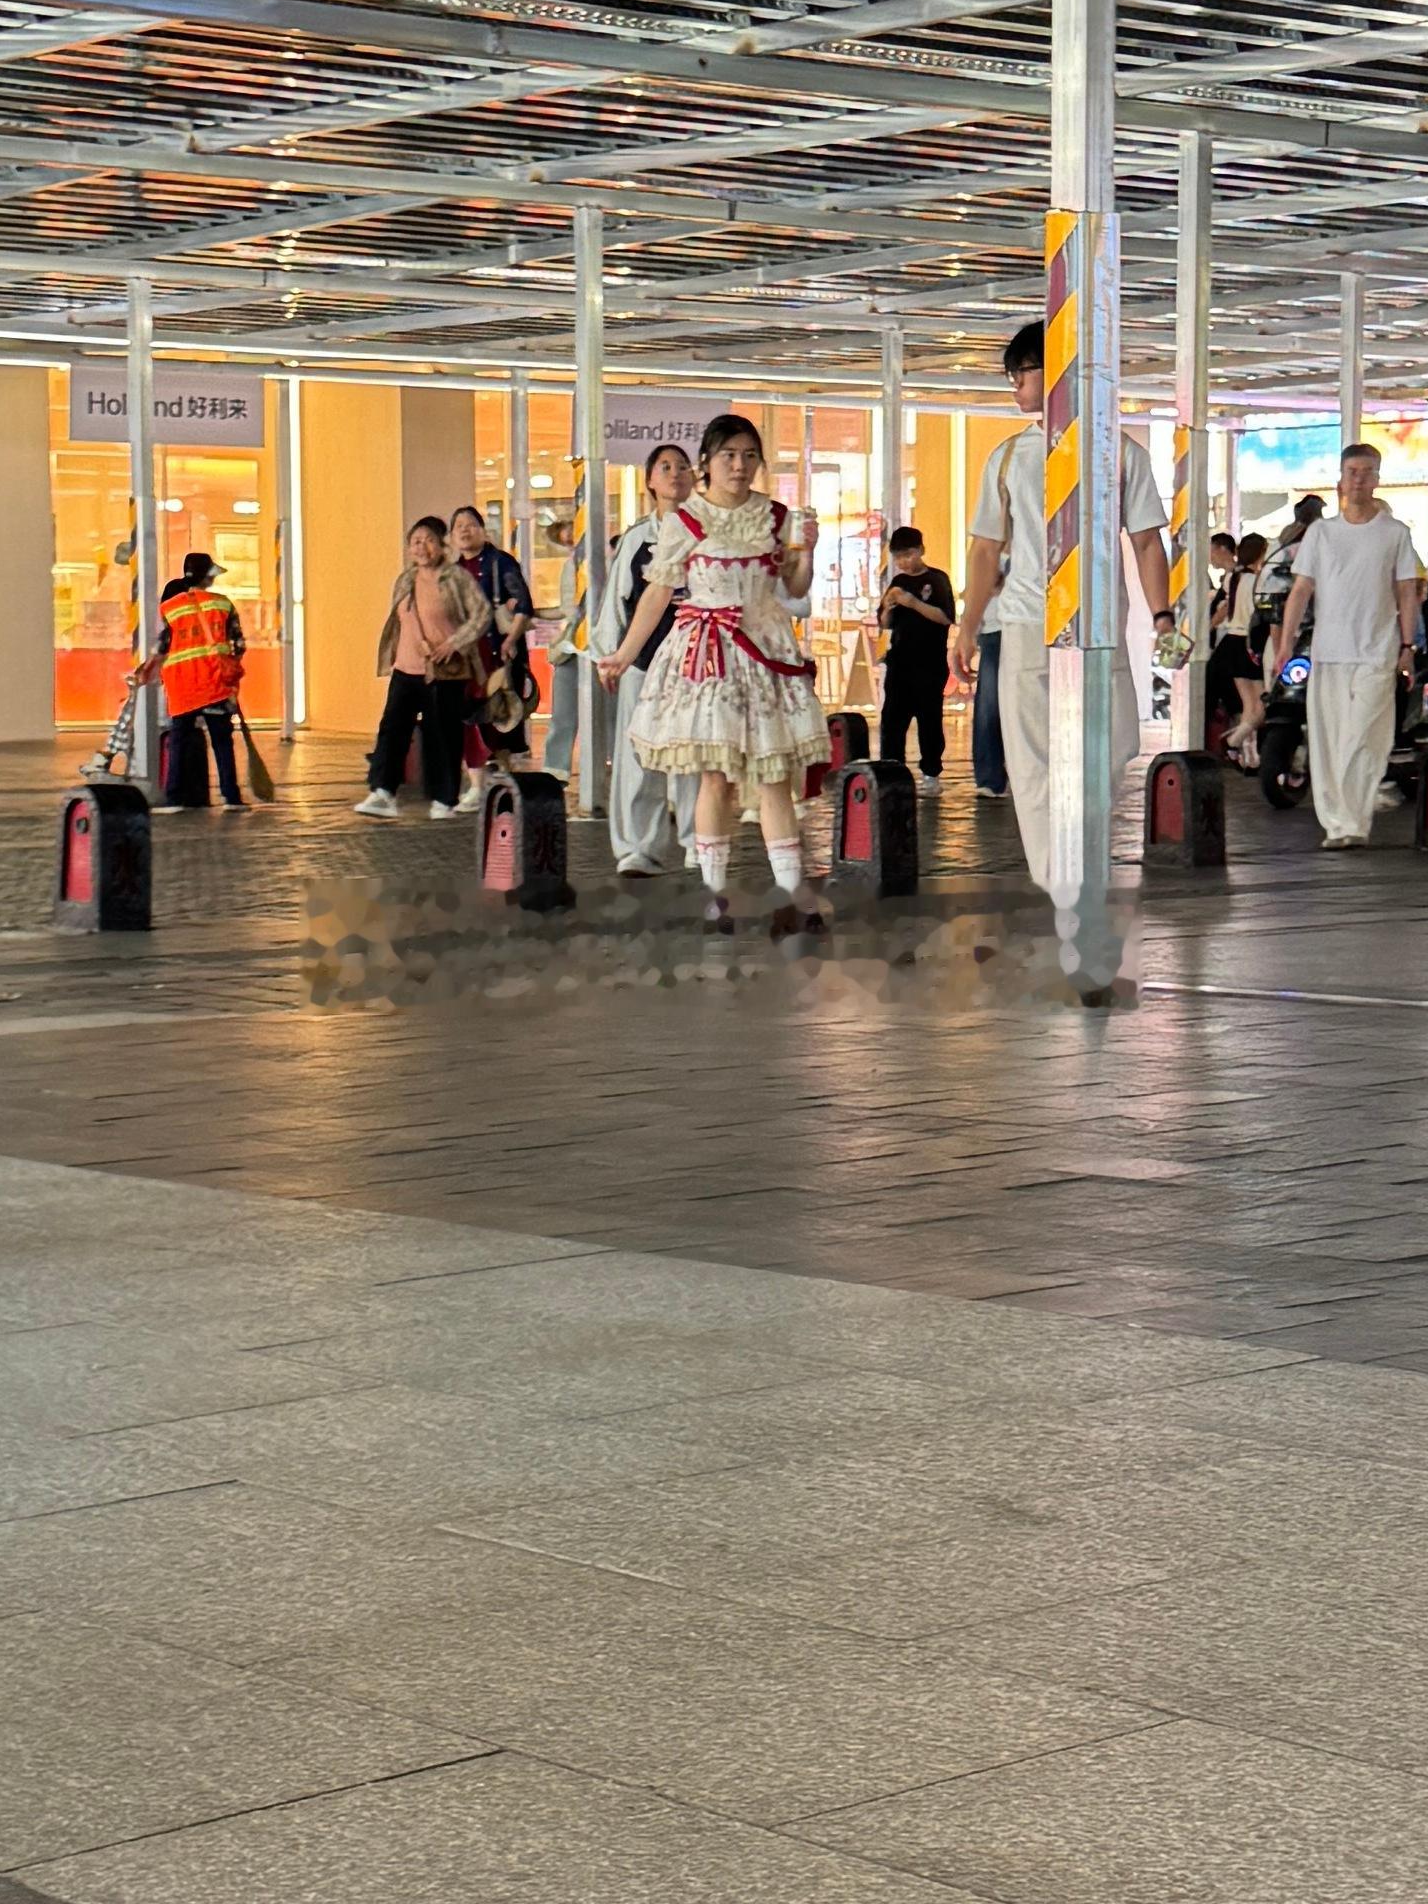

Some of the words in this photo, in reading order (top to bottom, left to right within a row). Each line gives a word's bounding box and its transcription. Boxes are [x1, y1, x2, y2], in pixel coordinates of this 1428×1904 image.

[187, 396, 247, 419] 好利来
[603, 418, 663, 441] oliland
[668, 421, 707, 442] 好利
